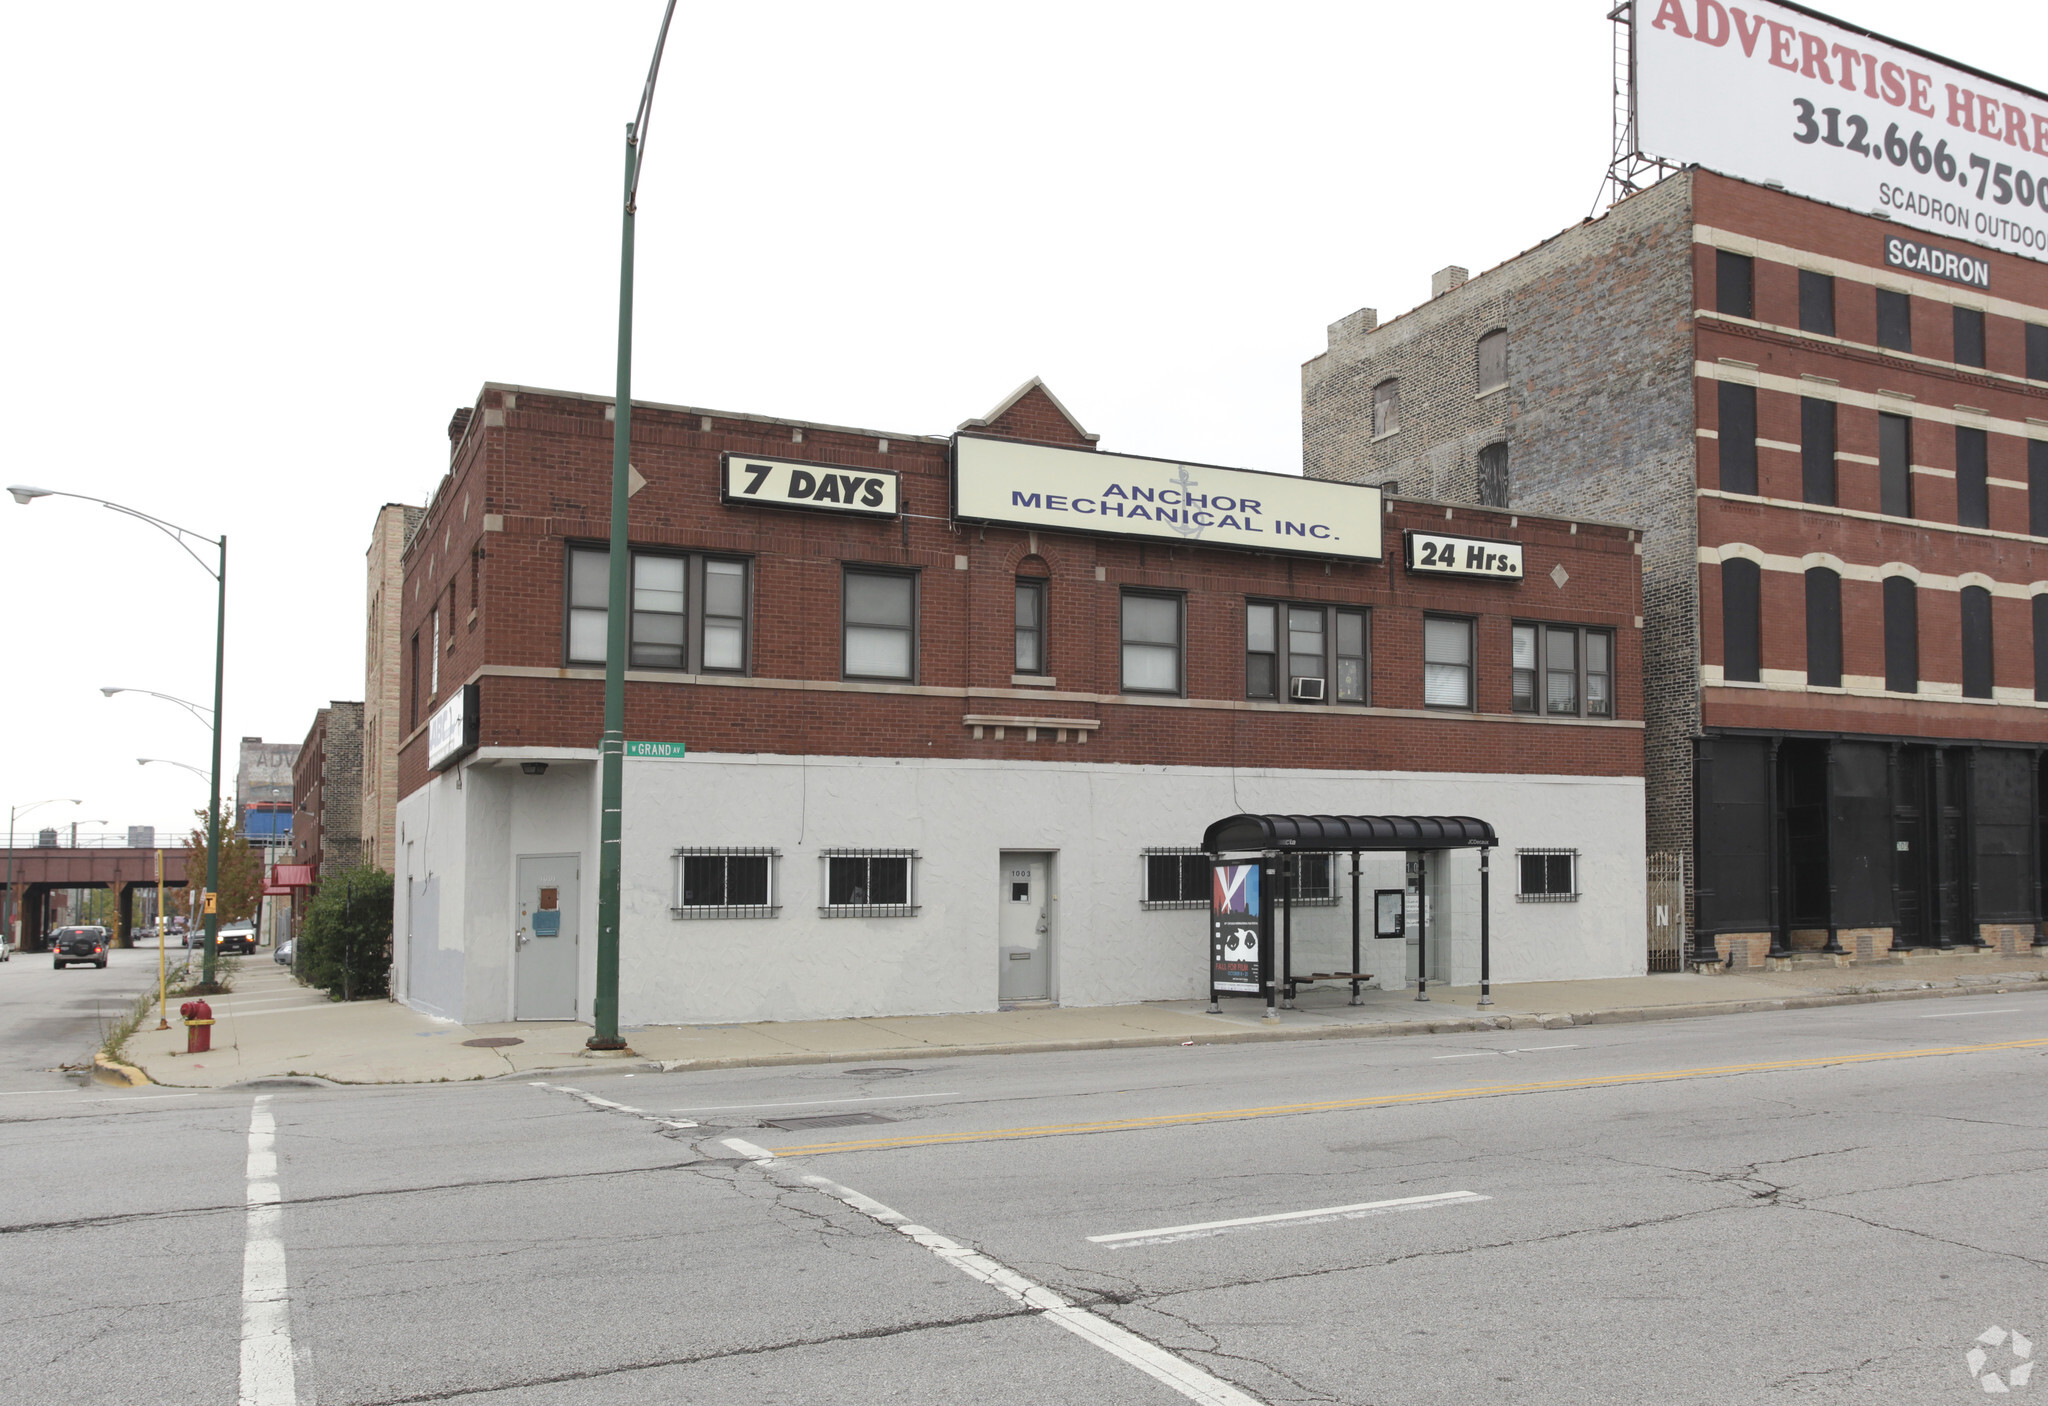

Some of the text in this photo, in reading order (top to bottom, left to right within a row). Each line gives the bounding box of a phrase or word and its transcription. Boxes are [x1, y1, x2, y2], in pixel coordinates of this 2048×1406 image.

[1651, 0, 2048, 158] ADVERTISE HERE
[1793, 97, 2048, 214] 312.666.7500
[1879, 182, 2048, 252] SCADRON OUTDOO
[1889, 239, 1989, 286] SCADRON
[743, 464, 884, 508] 7 DAYS
[1102, 483, 1262, 516] ANCHOR
[1011, 490, 1341, 540] MECHANICAL INC.
[1421, 541, 1518, 573] 24 Hrs.
[638, 743, 671, 756] GRAND
[1656, 904, 1669, 927] N
